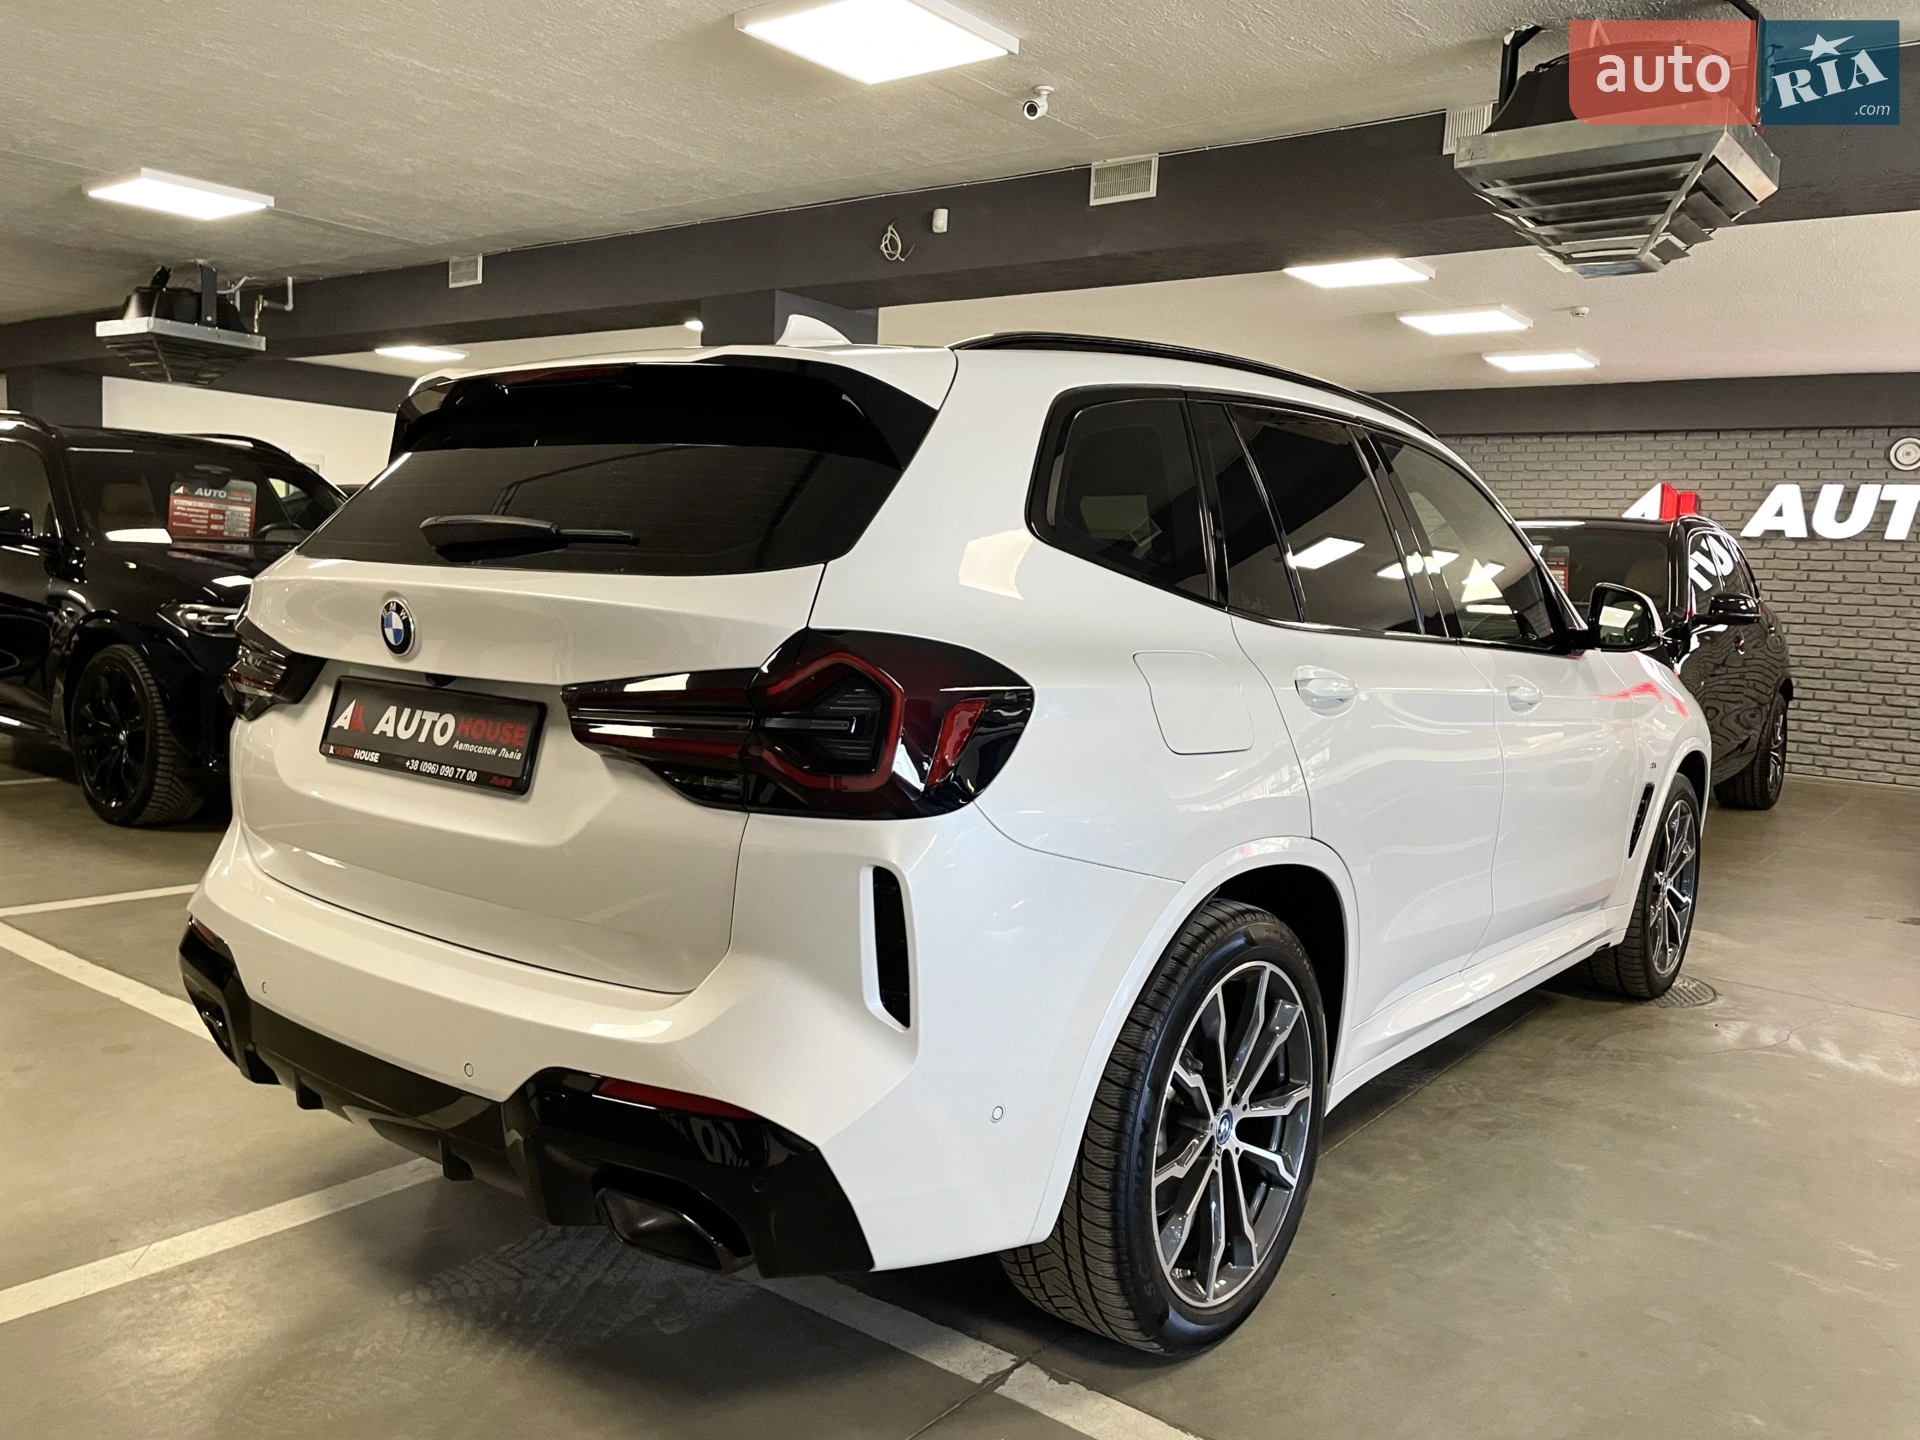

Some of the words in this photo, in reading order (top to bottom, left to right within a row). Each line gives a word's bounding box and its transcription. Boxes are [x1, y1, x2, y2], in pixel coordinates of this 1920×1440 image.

[194, 487, 228, 498] AUTO
[373, 705, 456, 747] AUTO
[456, 716, 528, 747] HOUSE
[353, 748, 380, 763] HOUSE
[452, 740, 498, 757] Автосалон
[498, 747, 522, 761] Львів
[405, 759, 420, 771] +38
[419, 760, 439, 774] (096)
[439, 764, 455, 778] 090
[455, 768, 466, 780] 77
[466, 770, 477, 782] 00
